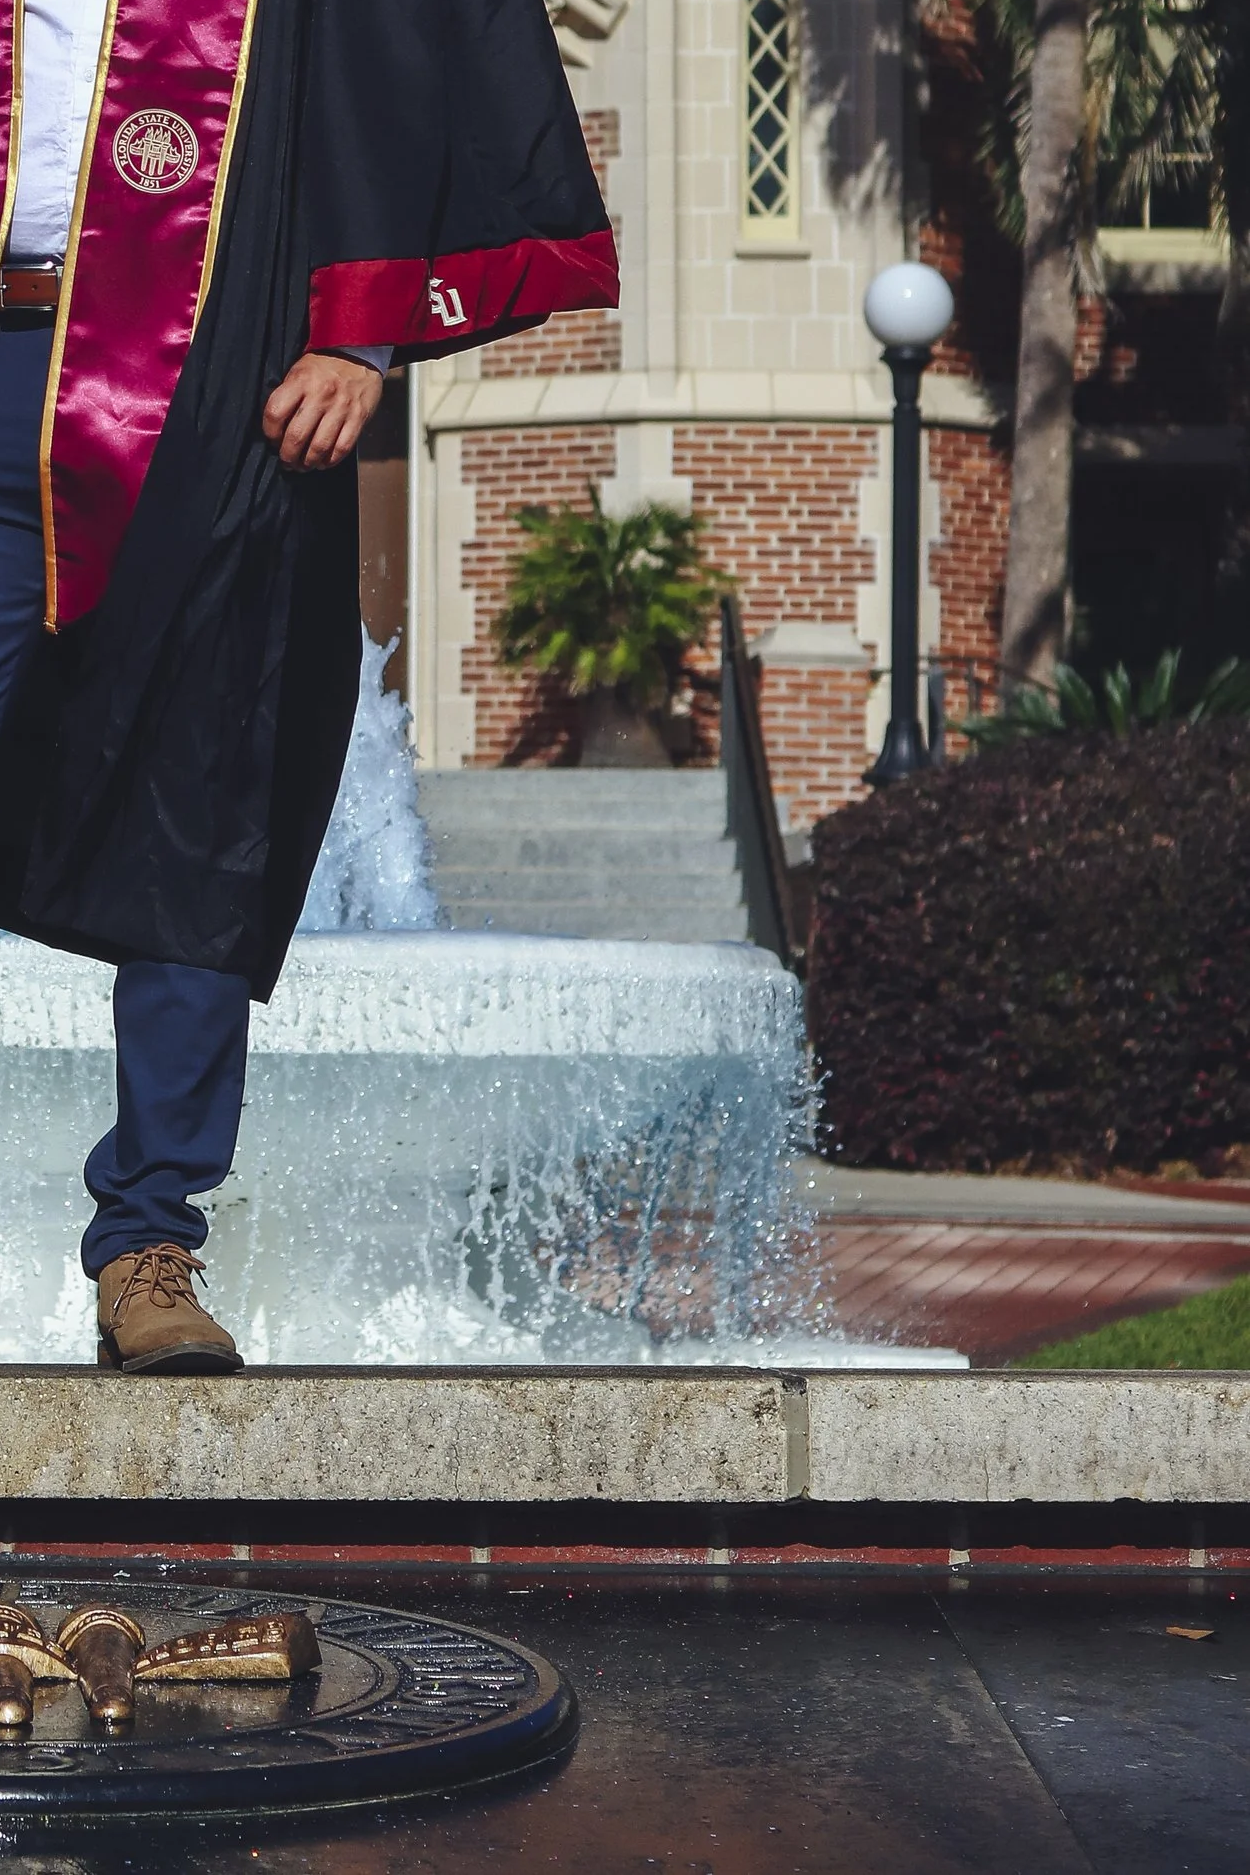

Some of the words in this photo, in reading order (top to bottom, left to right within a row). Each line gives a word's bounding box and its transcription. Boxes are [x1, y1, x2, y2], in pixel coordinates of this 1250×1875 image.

[118, 122, 139, 167] FLORIDA
[138, 114, 170, 125] STATE
[171, 120, 193, 179] UNIVERSITY
[138, 177, 160, 189] 1851
